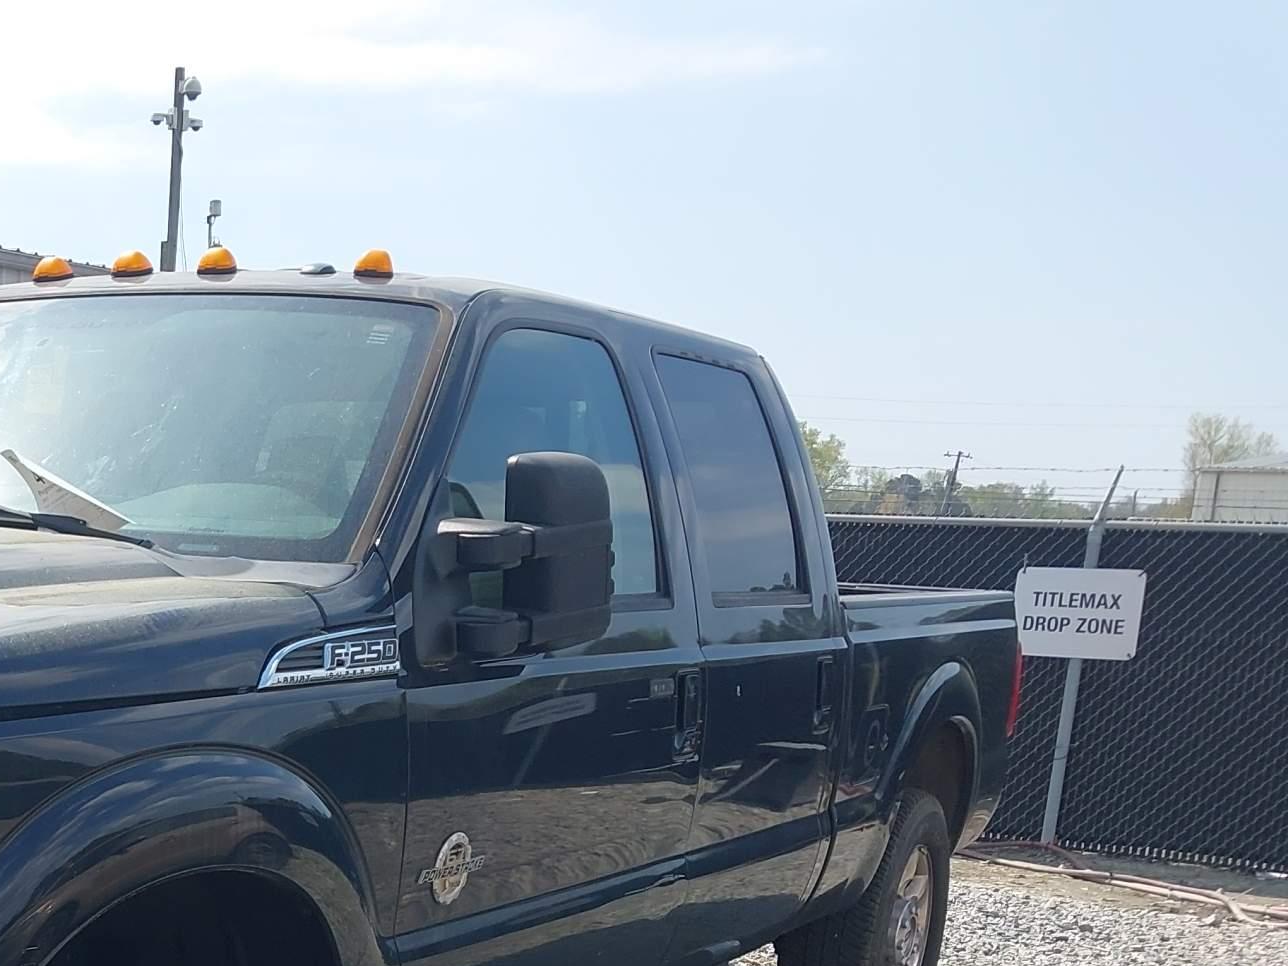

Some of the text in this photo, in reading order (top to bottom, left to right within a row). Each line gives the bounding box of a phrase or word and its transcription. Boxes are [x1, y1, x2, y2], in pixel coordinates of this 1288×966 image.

[1032, 591, 1123, 610] TITLEMAX
[1022, 615, 1126, 635] DROP ZONE
[327, 639, 398, 669] F-250
[276, 673, 312, 685] LARIAT
